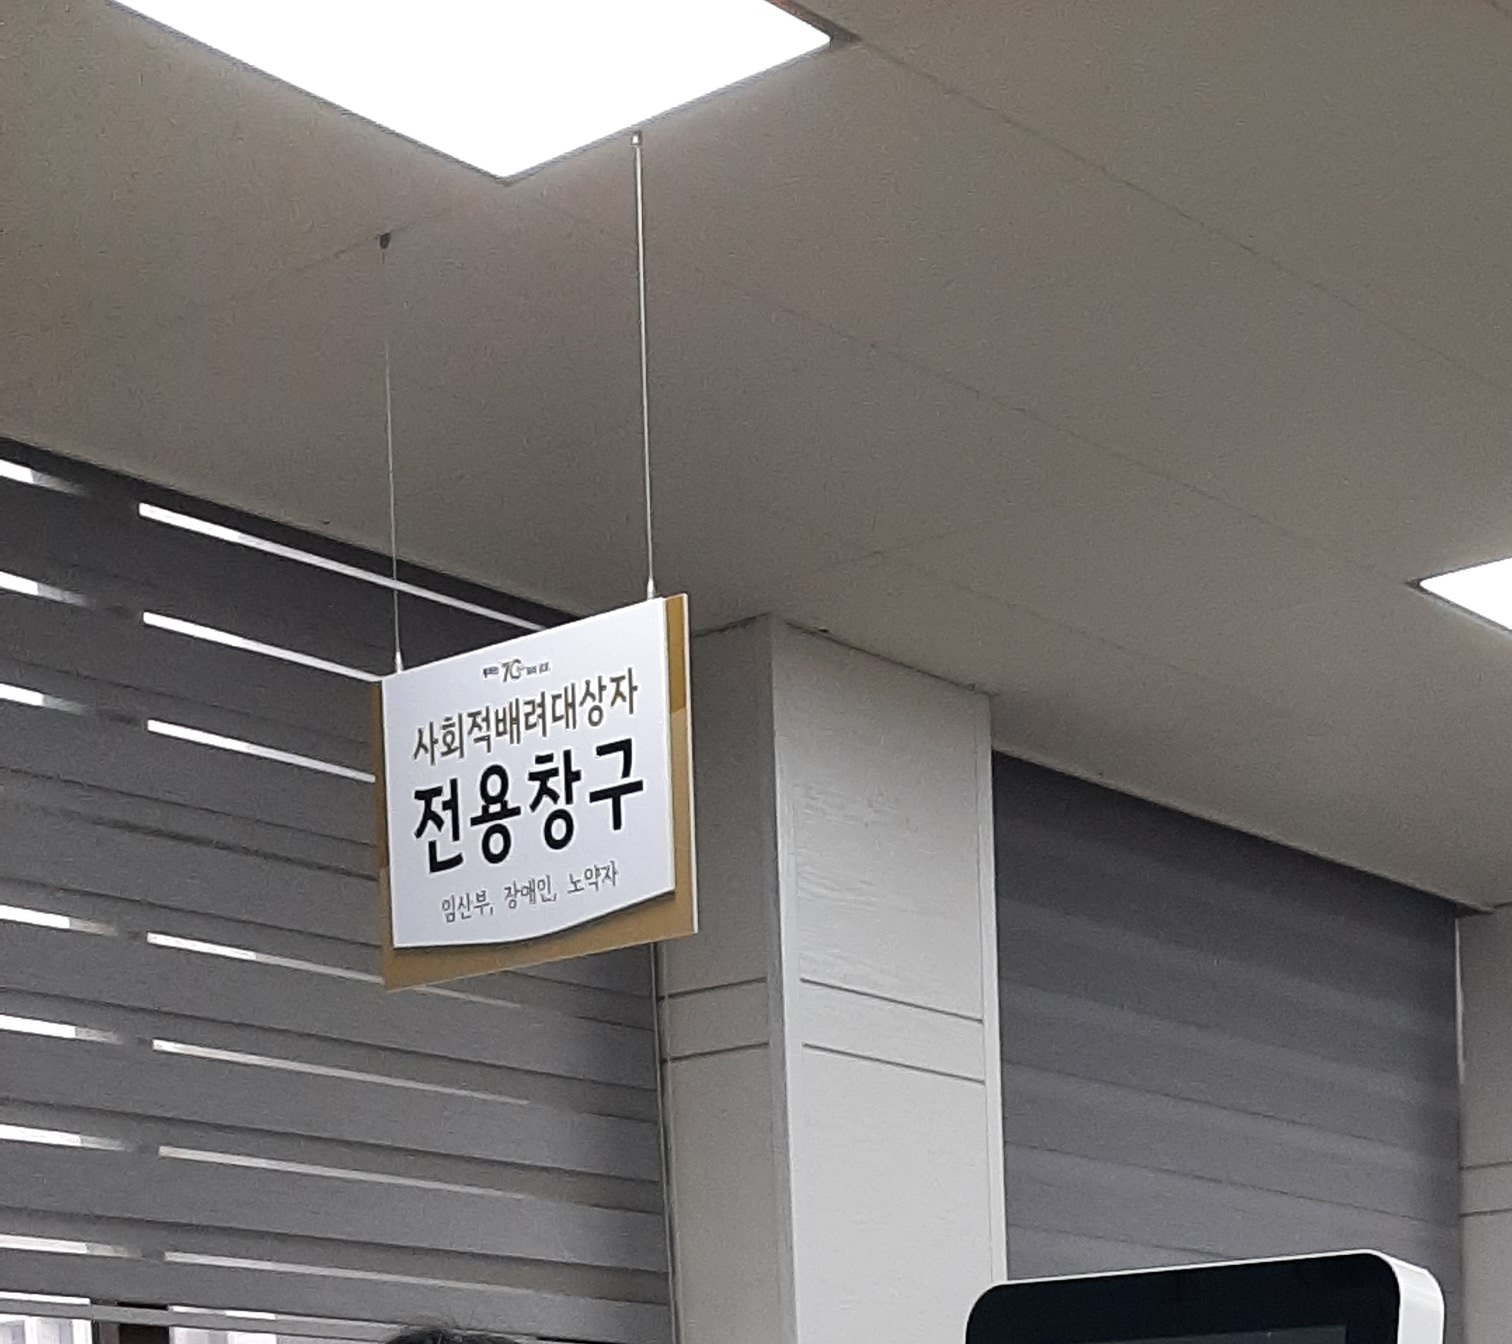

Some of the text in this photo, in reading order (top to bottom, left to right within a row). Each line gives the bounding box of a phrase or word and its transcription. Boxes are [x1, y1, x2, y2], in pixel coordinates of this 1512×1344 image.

[413, 667, 639, 768] 사회적배려대상자
[413, 738, 644, 874] 전용창구
[441, 890, 494, 924] 임산부,
[566, 860, 619, 898] 노약자
